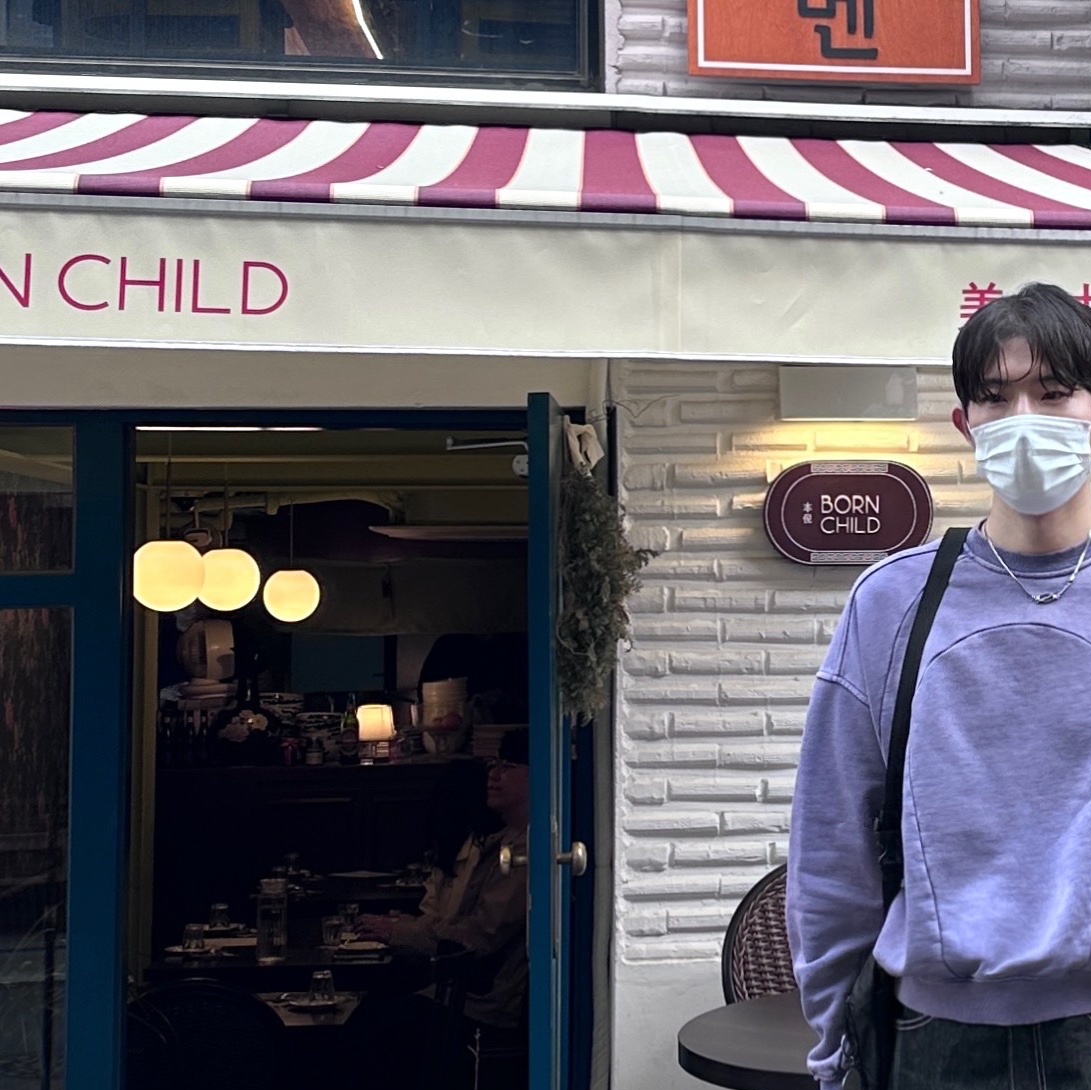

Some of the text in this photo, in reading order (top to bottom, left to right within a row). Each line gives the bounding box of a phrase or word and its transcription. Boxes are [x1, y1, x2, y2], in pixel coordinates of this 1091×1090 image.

[58, 254, 289, 315] CHILD
[820, 494, 880, 514] BORN
[820, 516, 881, 534] CHILD
